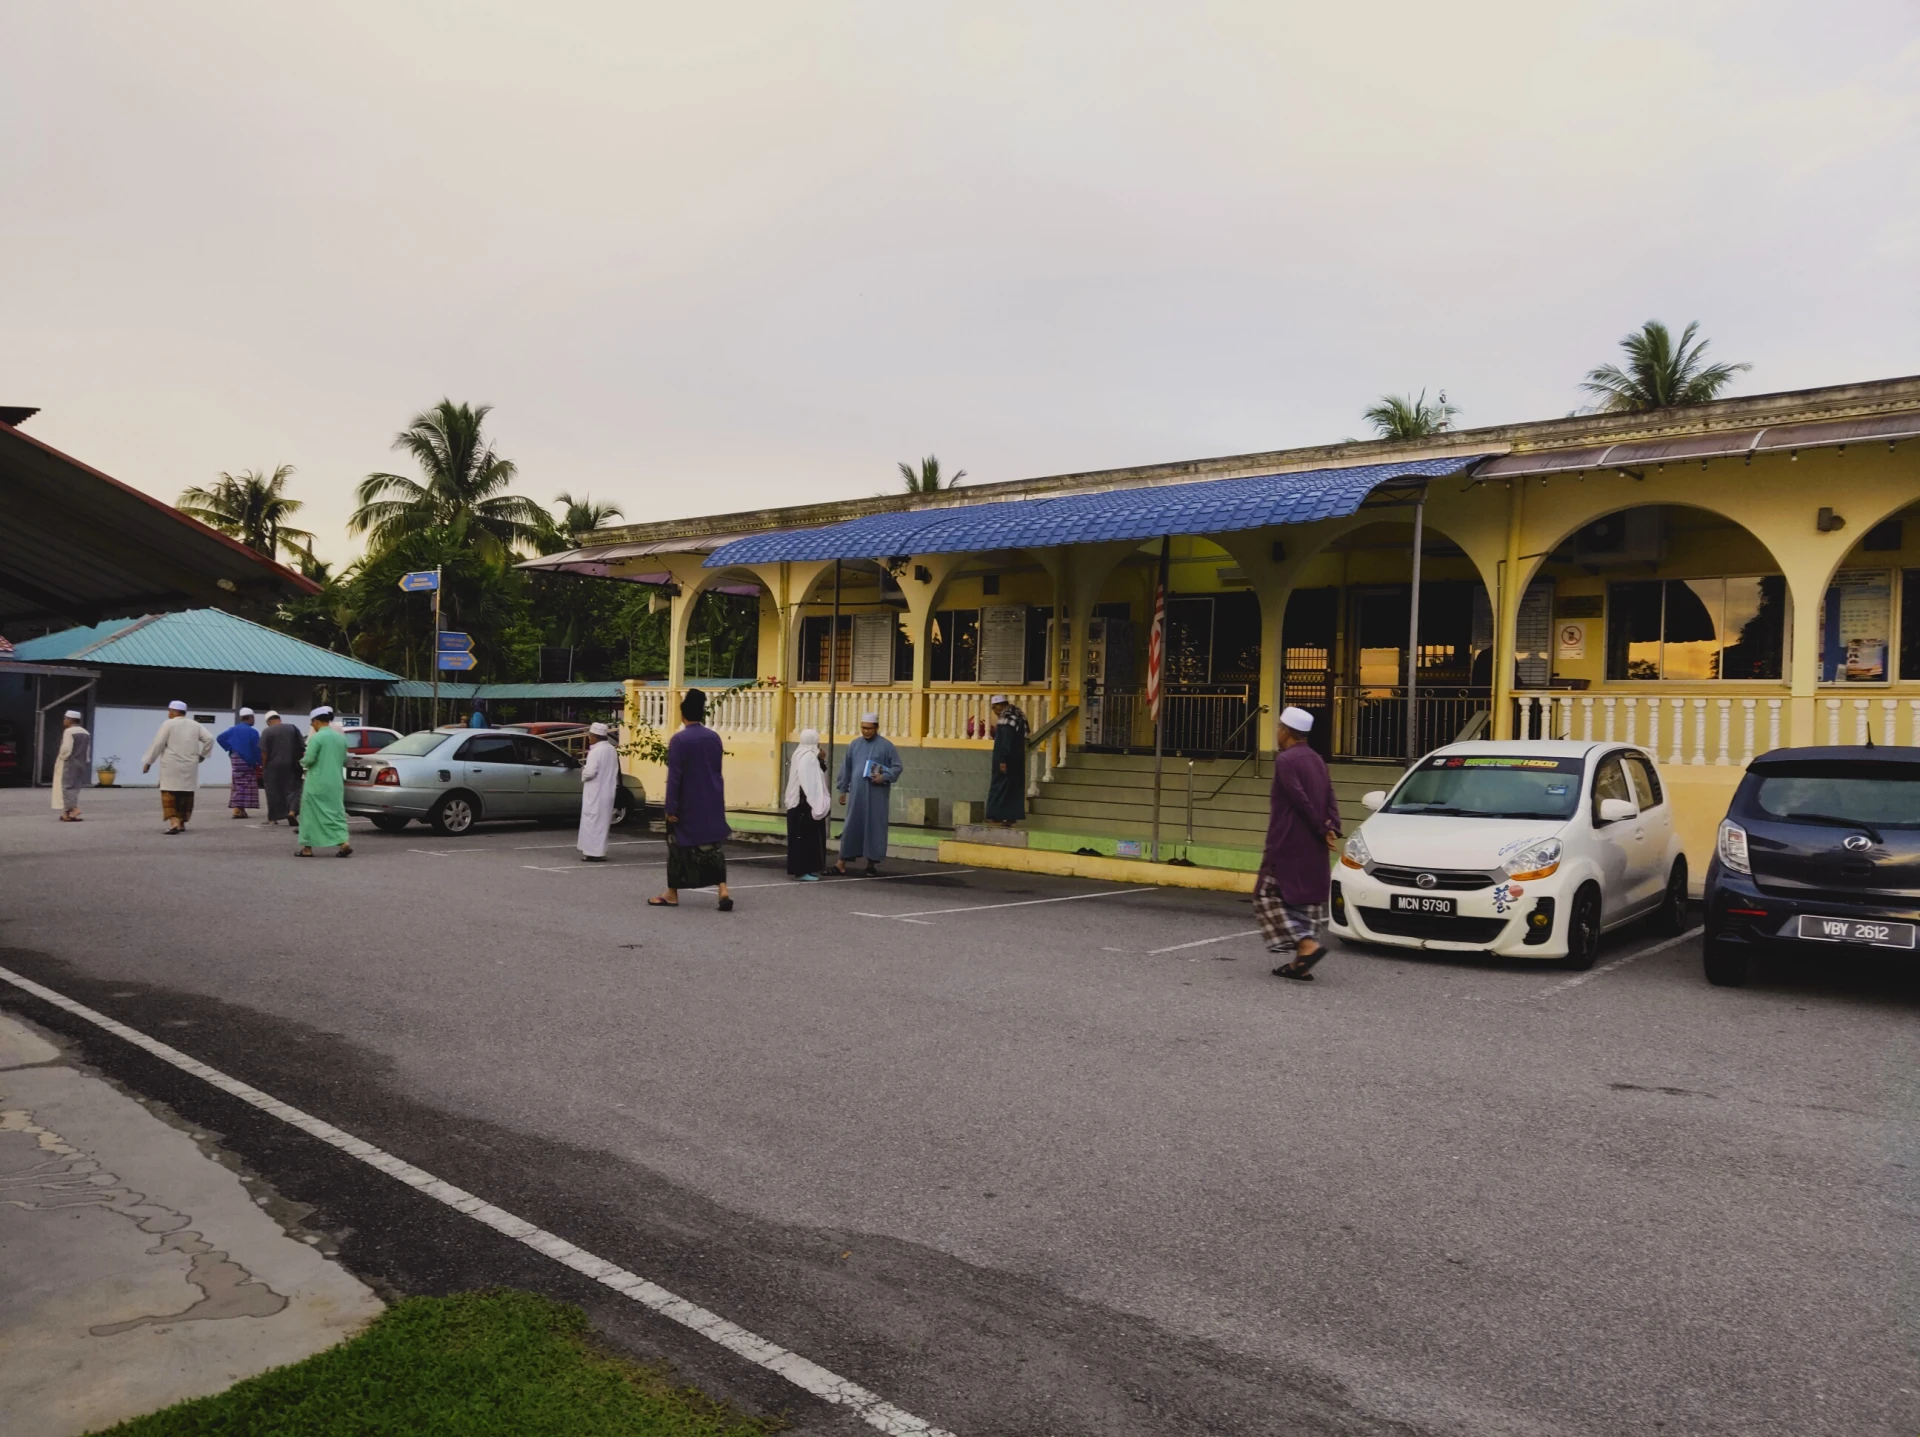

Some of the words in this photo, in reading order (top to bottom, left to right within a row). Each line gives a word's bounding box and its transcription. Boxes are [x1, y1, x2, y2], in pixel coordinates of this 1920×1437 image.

[1398, 897, 1419, 910] MCN
[1422, 899, 1450, 912] 9790
[1823, 921, 1849, 936] VBY
[1855, 924, 1889, 940] 2612
